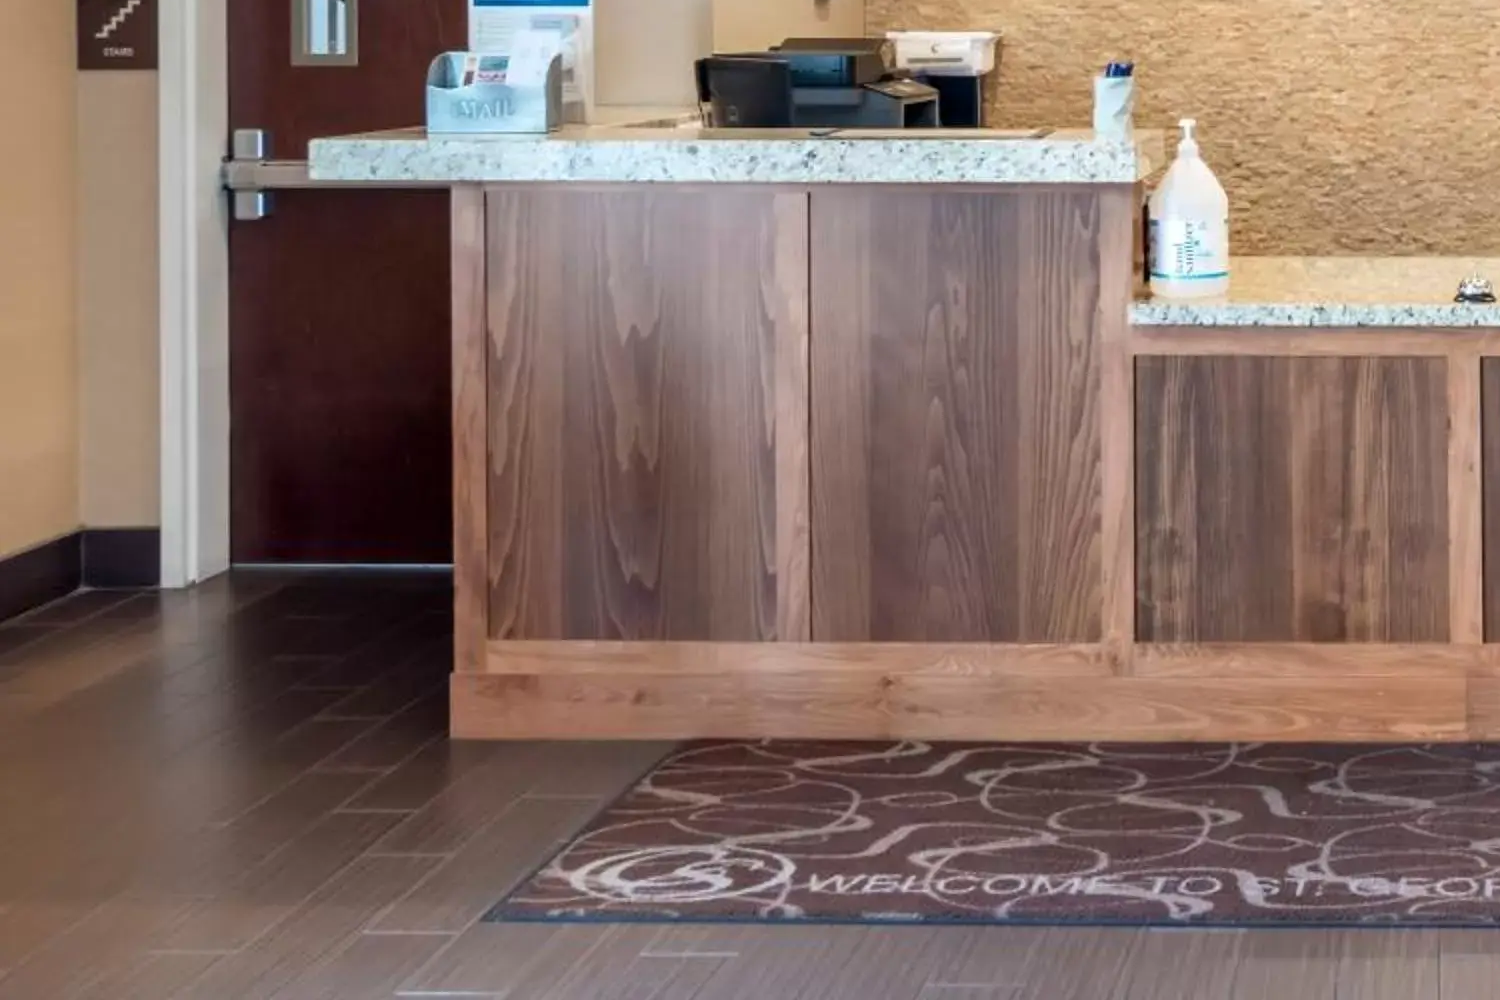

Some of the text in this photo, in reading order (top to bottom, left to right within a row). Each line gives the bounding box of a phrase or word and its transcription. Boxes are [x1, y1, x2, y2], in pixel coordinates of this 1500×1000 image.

[103, 47, 134, 57] STAIRS
[457, 99, 516, 120] MAIL
[808, 873, 1111, 895] WELCOME
[1148, 874, 1223, 894] TO
